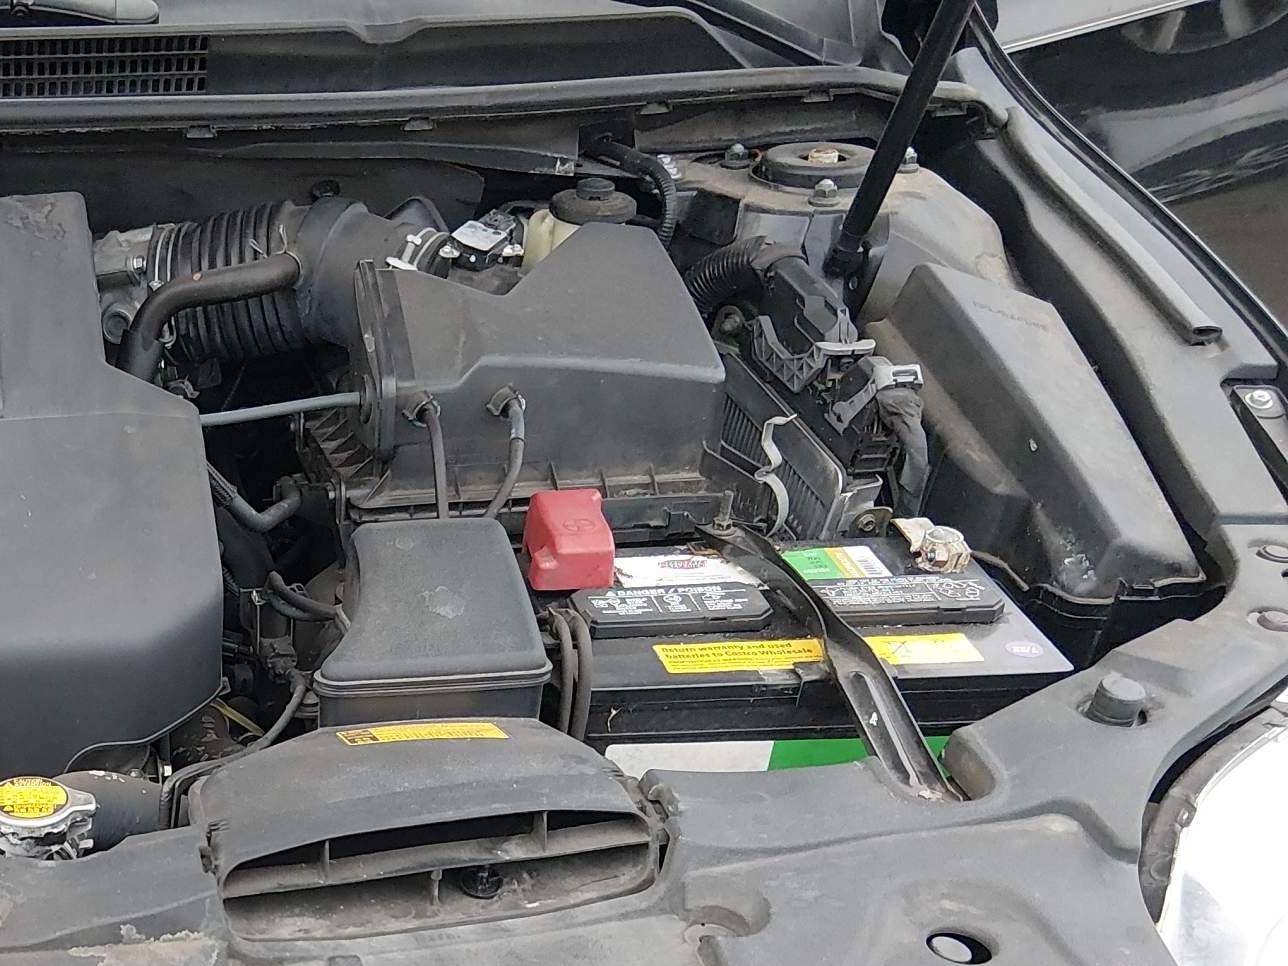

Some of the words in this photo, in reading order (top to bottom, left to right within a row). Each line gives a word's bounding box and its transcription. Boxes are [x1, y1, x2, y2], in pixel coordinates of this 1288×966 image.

[617, 588, 665, 597] DANGER
[677, 585, 722, 595] POISON
[665, 651, 711, 660] batteries
[759, 647, 813, 656] Wholesale
